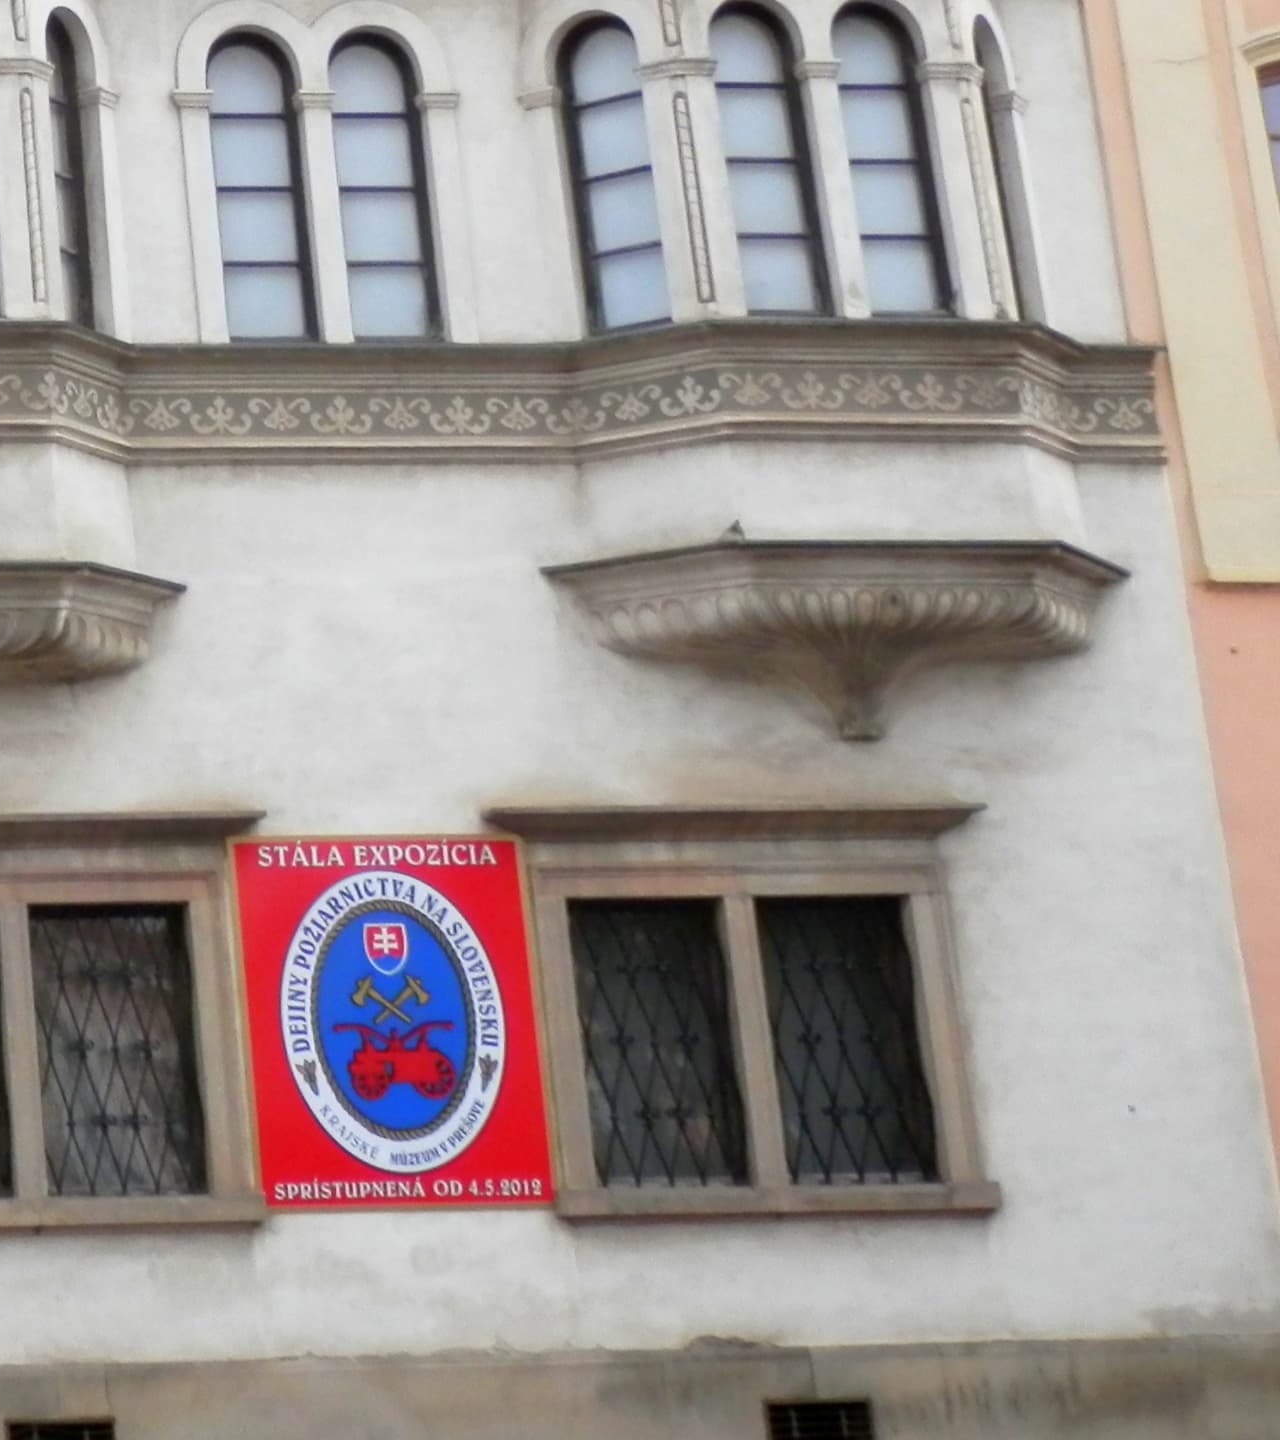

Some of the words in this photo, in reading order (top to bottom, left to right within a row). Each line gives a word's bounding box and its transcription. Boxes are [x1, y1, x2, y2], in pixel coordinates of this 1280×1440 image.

[258, 840, 345, 867] STÁLA
[354, 840, 497, 866] EXPOZÍCIA
[294, 878, 417, 970] POŽIARNICTVA
[422, 893, 449, 925] NA
[447, 922, 499, 1048] SLOVENSKU
[288, 974, 311, 1054] DEJINY
[274, 1177, 426, 1201] SPRÍSTUPNENÁ
[433, 1179, 463, 1196] OD
[468, 1178, 542, 1197] 4.5.2012
